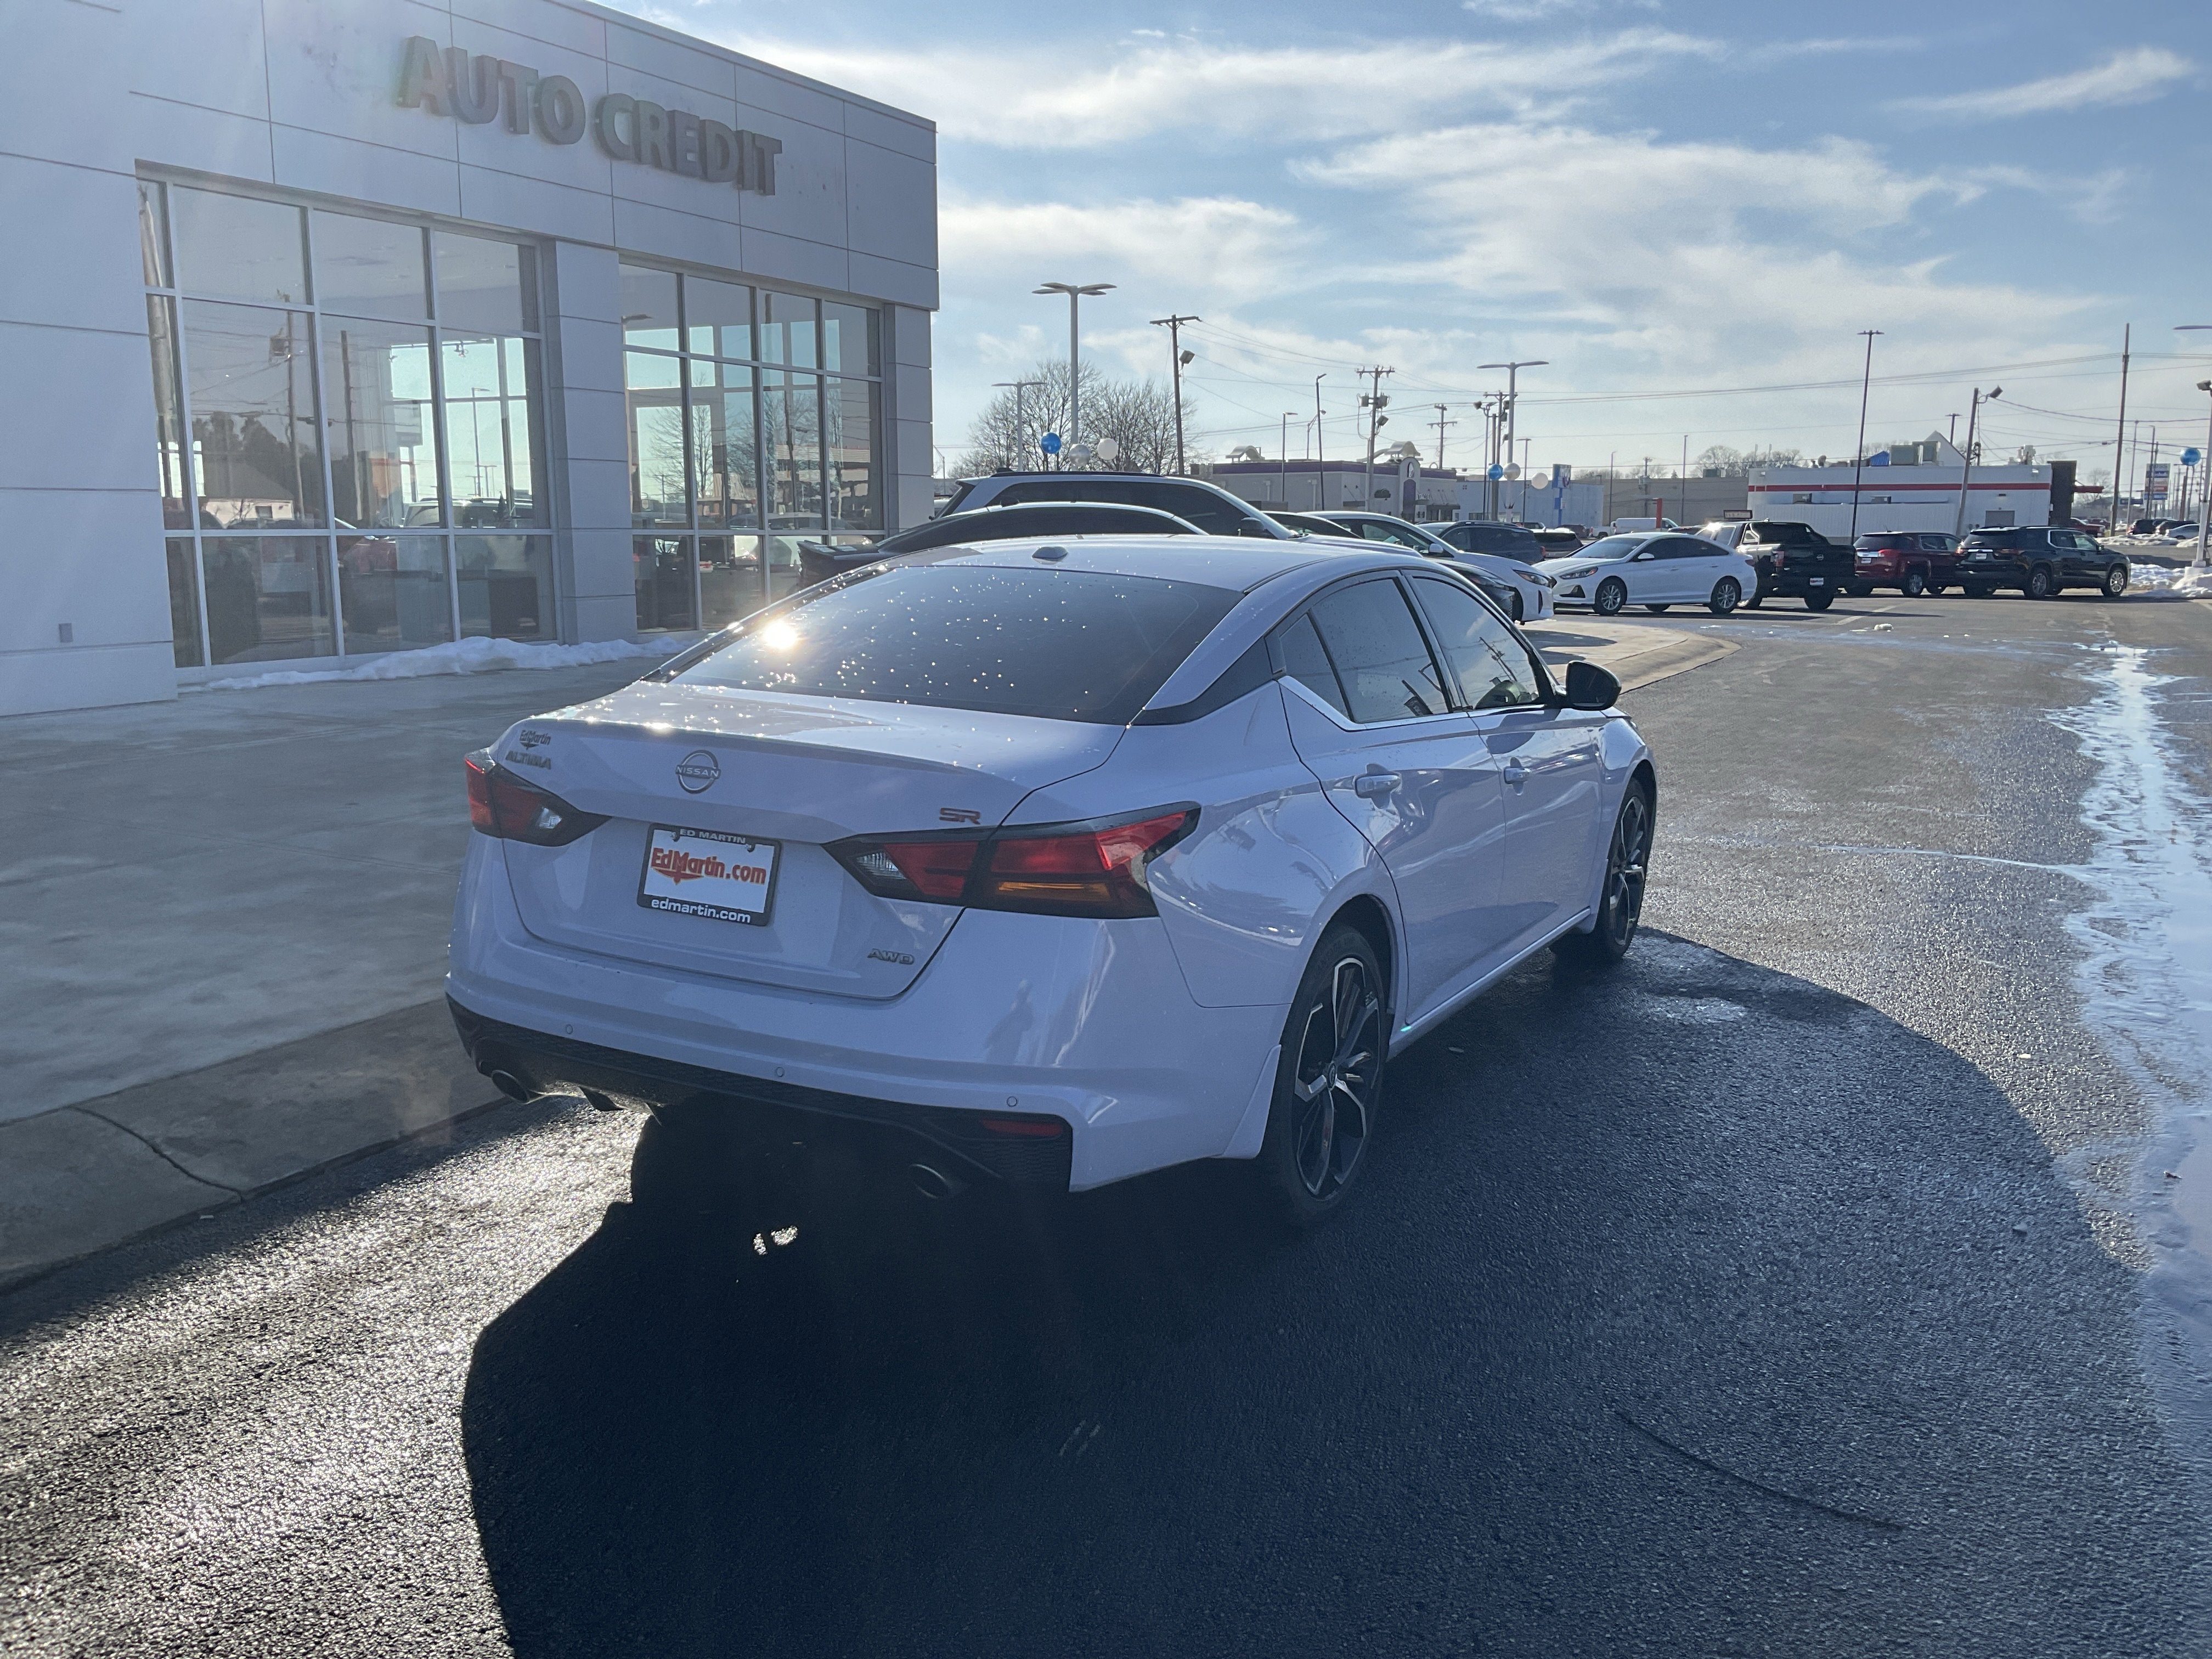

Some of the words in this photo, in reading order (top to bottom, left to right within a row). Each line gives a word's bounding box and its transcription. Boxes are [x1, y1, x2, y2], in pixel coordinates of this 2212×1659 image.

[397, 35, 586, 145] AUTO
[594, 93, 782, 196] CREDIT
[505, 750, 551, 770] ALTIMA
[676, 766, 719, 777] NISSAN
[939, 807, 981, 825] SR
[680, 828, 696, 837] ED
[698, 831, 747, 844] MARTIN
[651, 847, 767, 885] EdMartin.com
[651, 898, 751, 923] edmartin.com
[867, 948, 915, 965] AWD
